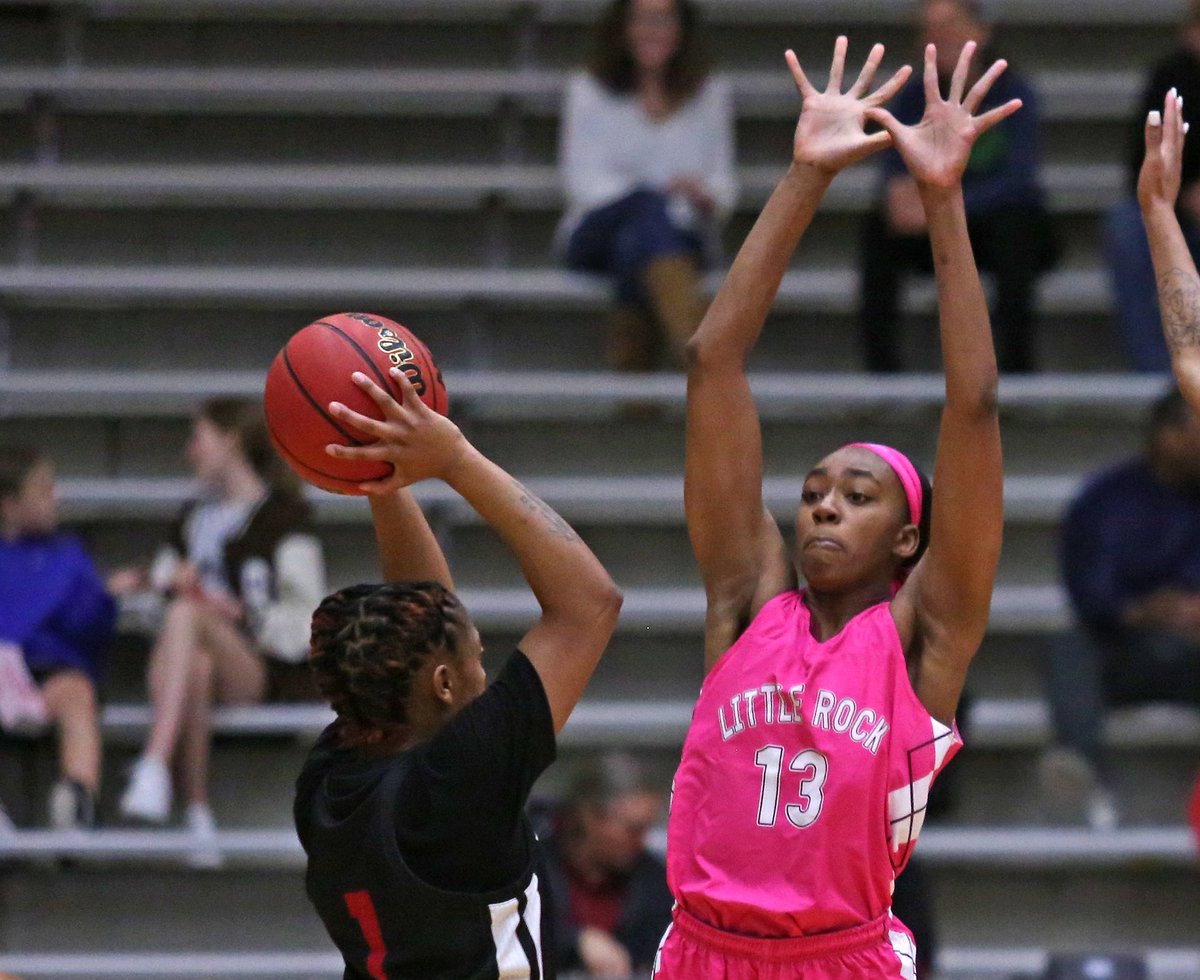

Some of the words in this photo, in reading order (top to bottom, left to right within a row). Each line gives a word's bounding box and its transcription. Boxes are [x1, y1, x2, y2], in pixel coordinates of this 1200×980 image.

[718, 683, 806, 742] LITTLE
[811, 689, 890, 755] ROCK
[755, 744, 829, 829] 13
